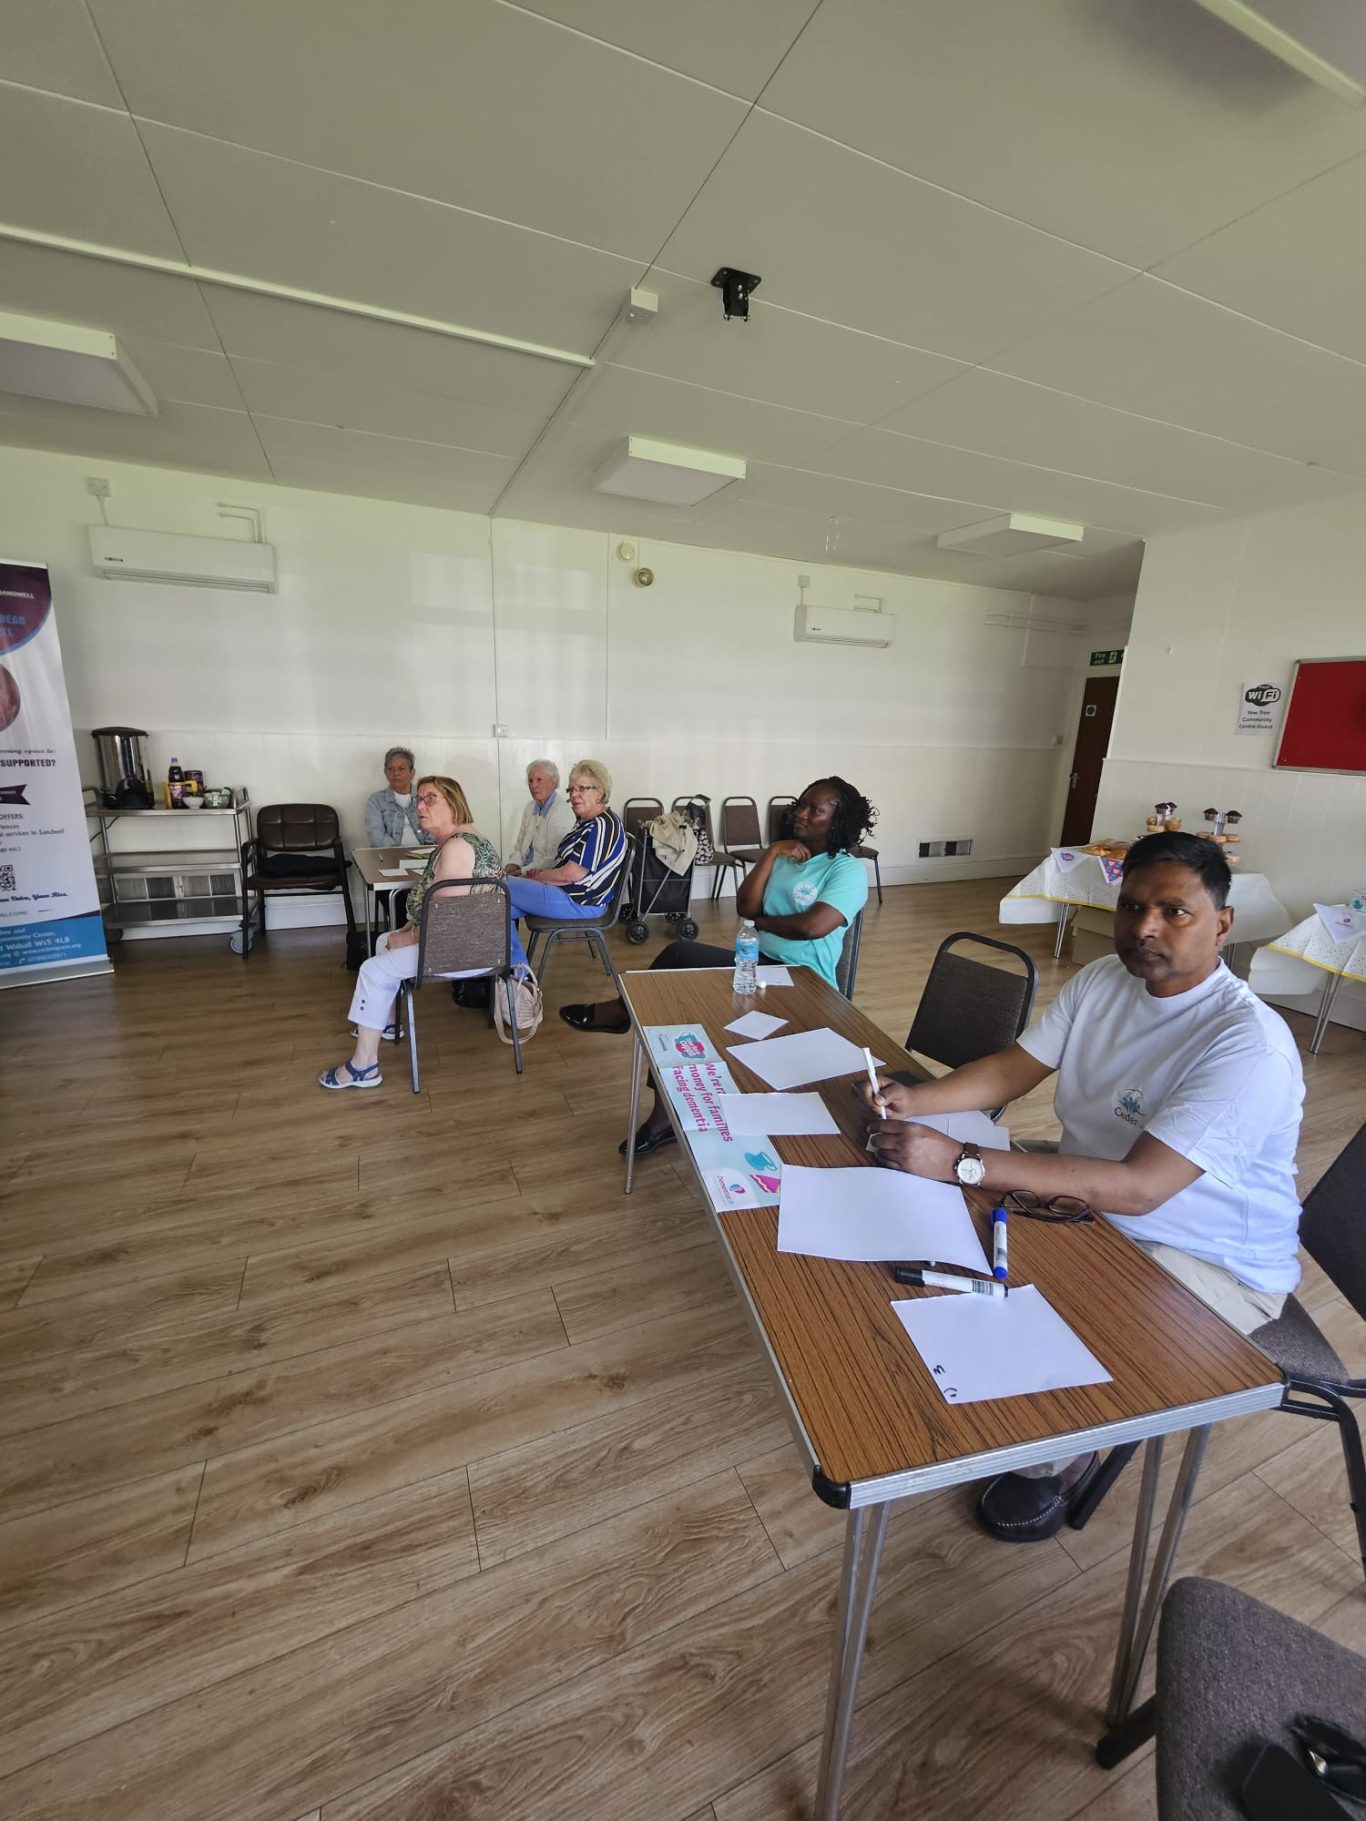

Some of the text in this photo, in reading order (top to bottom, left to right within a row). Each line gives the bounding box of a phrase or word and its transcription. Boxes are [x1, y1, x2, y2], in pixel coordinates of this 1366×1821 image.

[0, 759, 57, 768] SUPPORTED?
[672, 1065, 711, 1133] facing dementia
[689, 1063, 707, 1092] money
[701, 1092, 714, 1105] for
